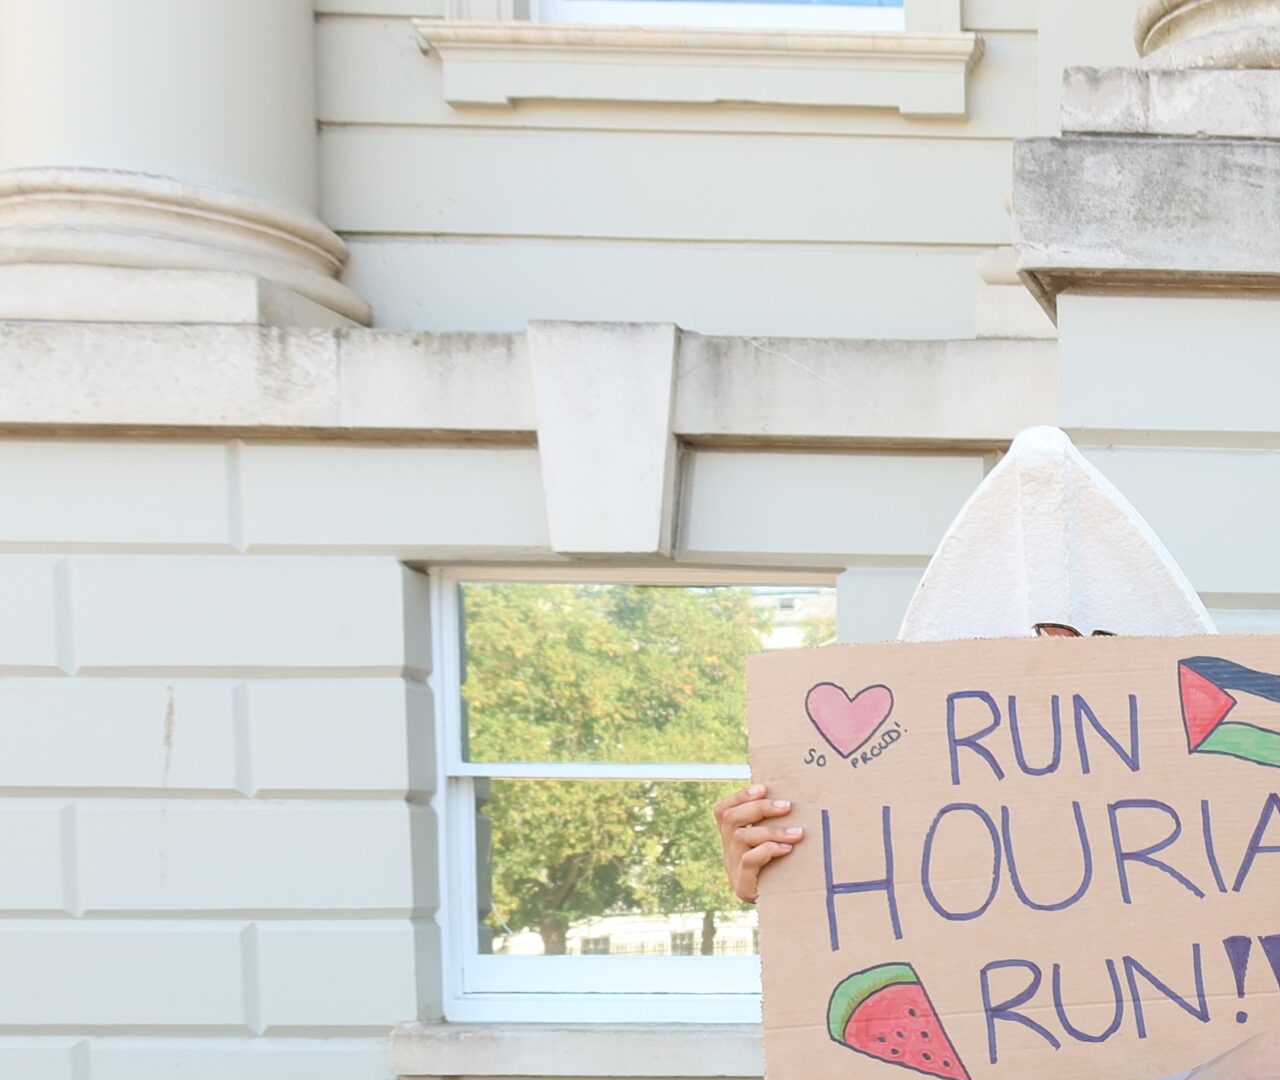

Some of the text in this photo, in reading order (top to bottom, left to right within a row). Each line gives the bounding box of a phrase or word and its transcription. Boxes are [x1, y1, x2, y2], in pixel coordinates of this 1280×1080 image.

[804, 720, 908, 769] SO PROUD!
[946, 689, 1140, 786] RUN
